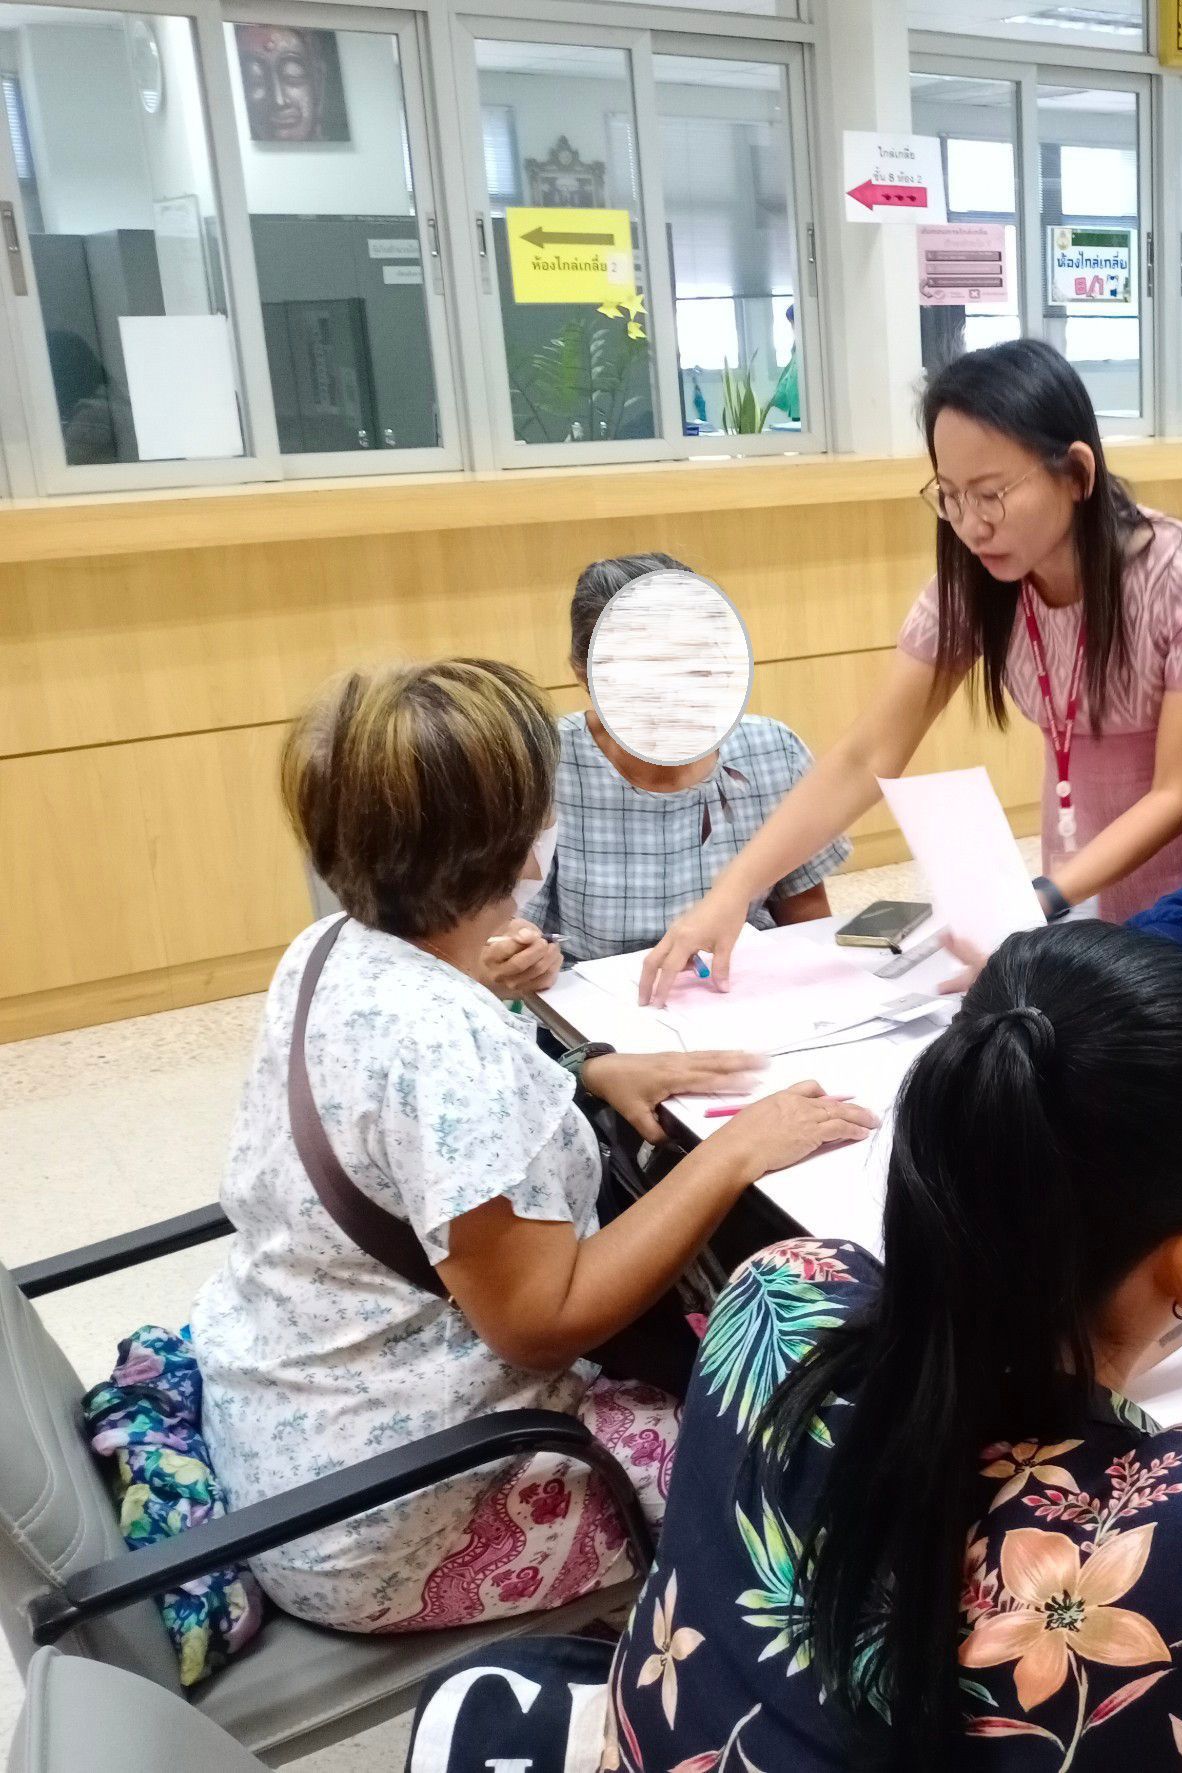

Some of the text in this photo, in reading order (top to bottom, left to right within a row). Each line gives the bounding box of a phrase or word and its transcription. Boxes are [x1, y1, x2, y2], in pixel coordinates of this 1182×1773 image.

[531, 254, 618, 273] ห้องไกล่เกลี่ย 2
[1056, 250, 1128, 270] ห้องไกล่เกลี่ย
